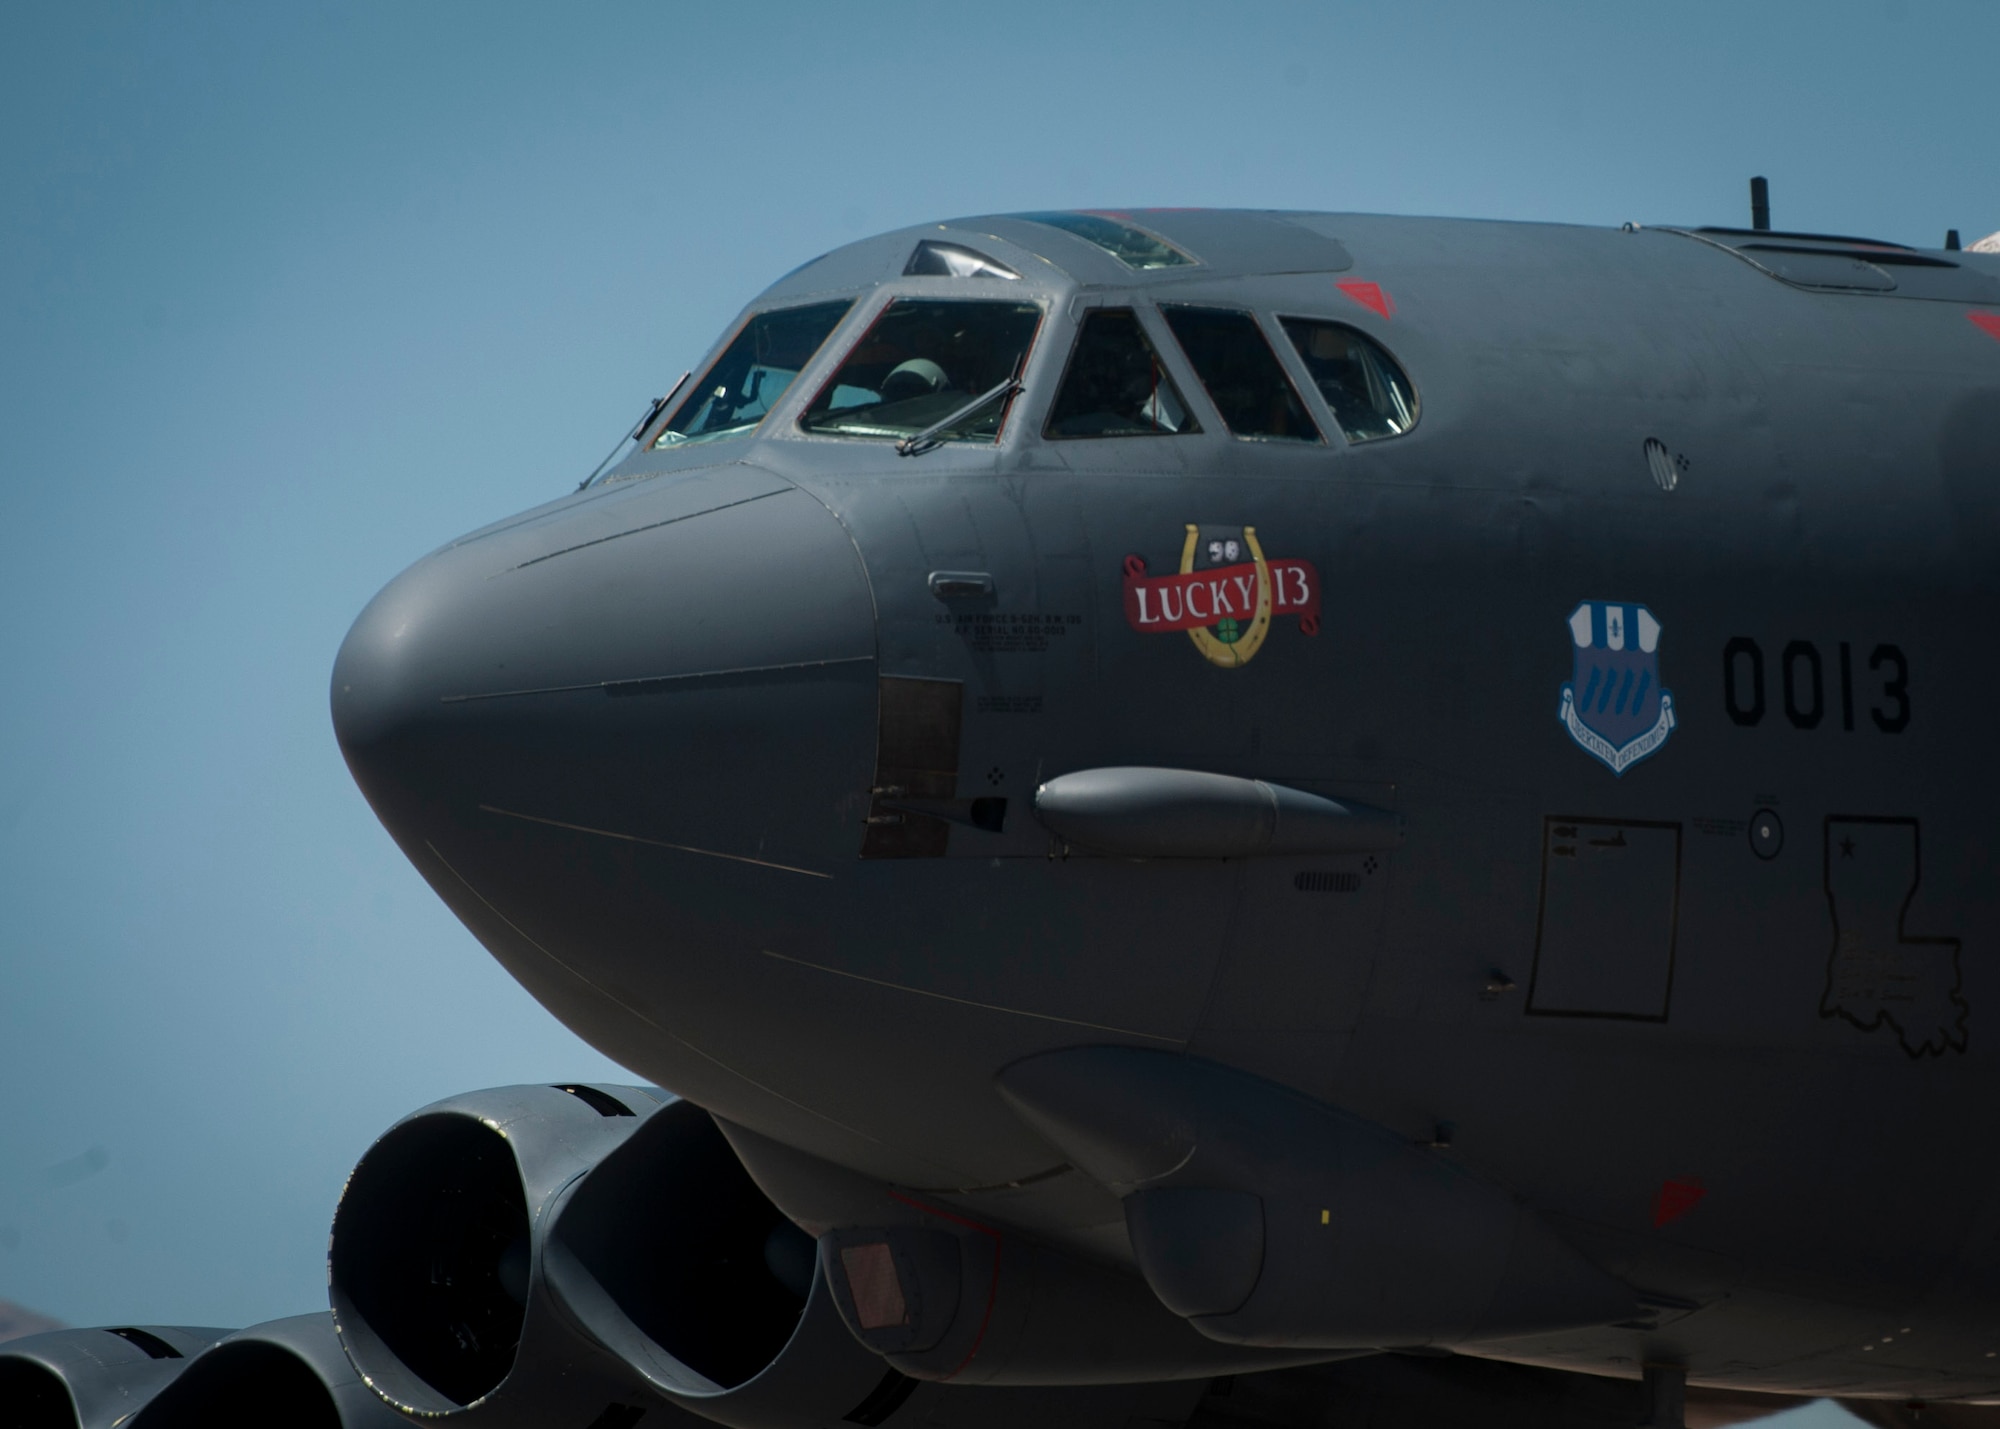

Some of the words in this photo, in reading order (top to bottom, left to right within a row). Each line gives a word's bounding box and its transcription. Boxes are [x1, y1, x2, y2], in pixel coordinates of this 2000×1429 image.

[1135, 574, 1256, 624] LUCKY
[1274, 567, 1310, 606] 13
[974, 624, 1008, 635] SERIAL
[975, 614, 1007, 624] FORCE
[1723, 636, 1912, 733] 0013
